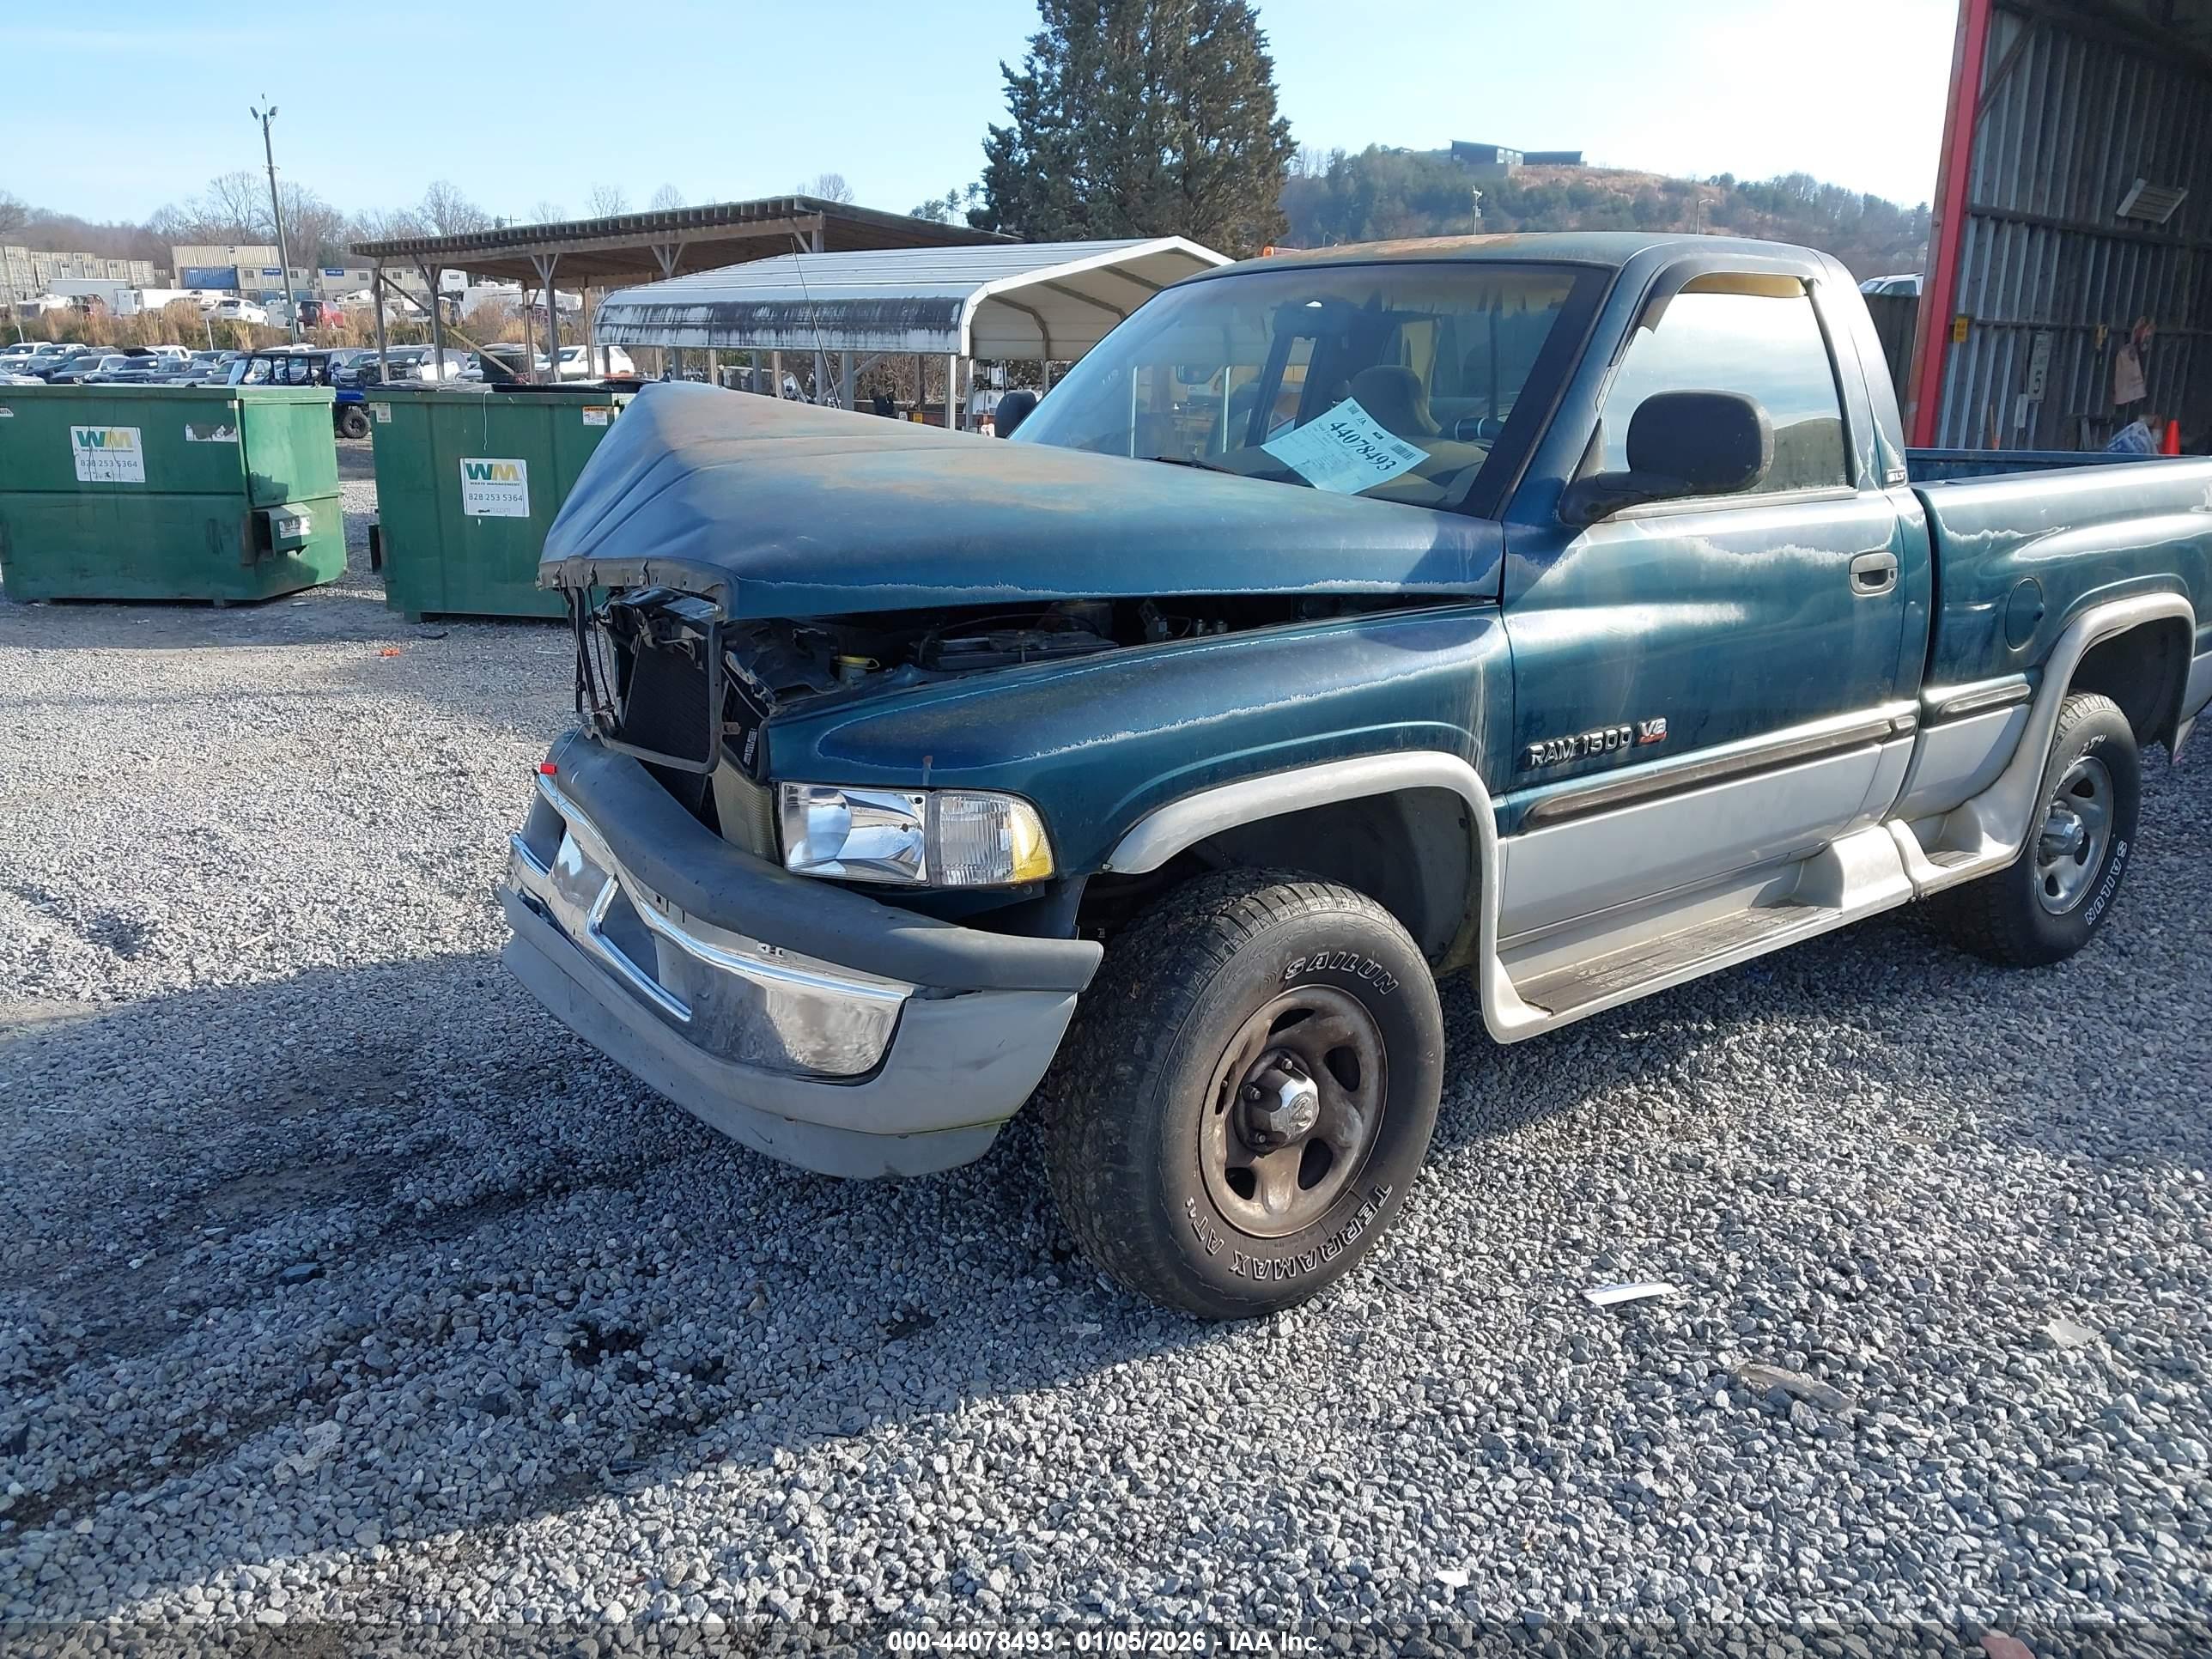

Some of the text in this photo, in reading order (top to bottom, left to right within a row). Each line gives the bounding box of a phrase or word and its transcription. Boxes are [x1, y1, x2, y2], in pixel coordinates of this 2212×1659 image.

[76, 431, 133, 447] WM
[1330, 422, 1397, 471] 44078493
[465, 464, 520, 481] WM
[485, 493, 501, 501] 253
[1530, 737, 1577, 766] RAM
[1581, 726, 1632, 756] 1500
[2084, 840, 2129, 926] SAILUN
[1285, 951, 1400, 996] SAILUN
[1229, 1183, 1394, 1282] TERRAMAX
